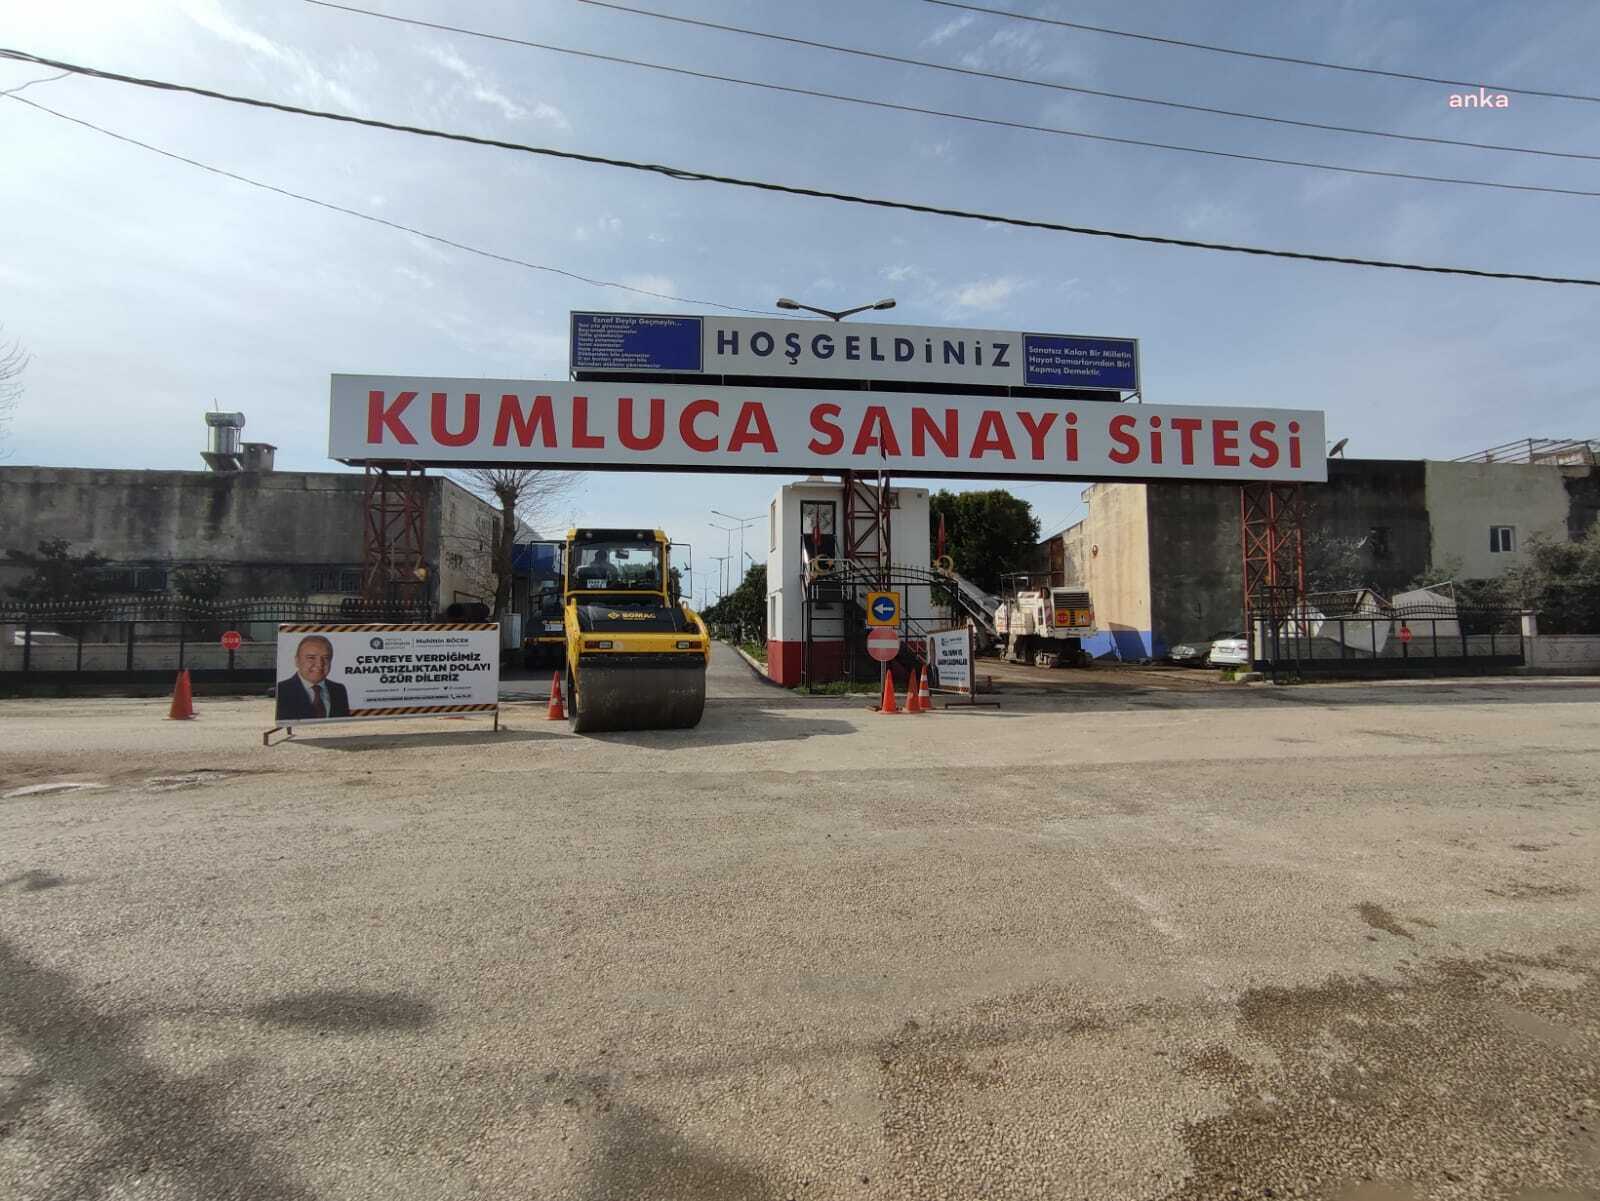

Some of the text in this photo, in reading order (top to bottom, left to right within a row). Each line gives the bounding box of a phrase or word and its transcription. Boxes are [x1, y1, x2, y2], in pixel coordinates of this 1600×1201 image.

[1064, 348, 1088, 356] Kalan
[1089, 349, 1101, 357] Bir
[1102, 350, 1132, 358] Milletin
[1028, 355, 1053, 365] Hayat
[1116, 359, 1131, 368] Biri
[366, 390, 779, 453] KUMLUCA
[356, 652, 481, 665] ÇEVREYE VERDİĞİMİZ
[345, 663, 491, 674] RAHATSIZLIKTAN DOLAYI
[379, 673, 460, 684] ÖZÜR DİLERİZ
